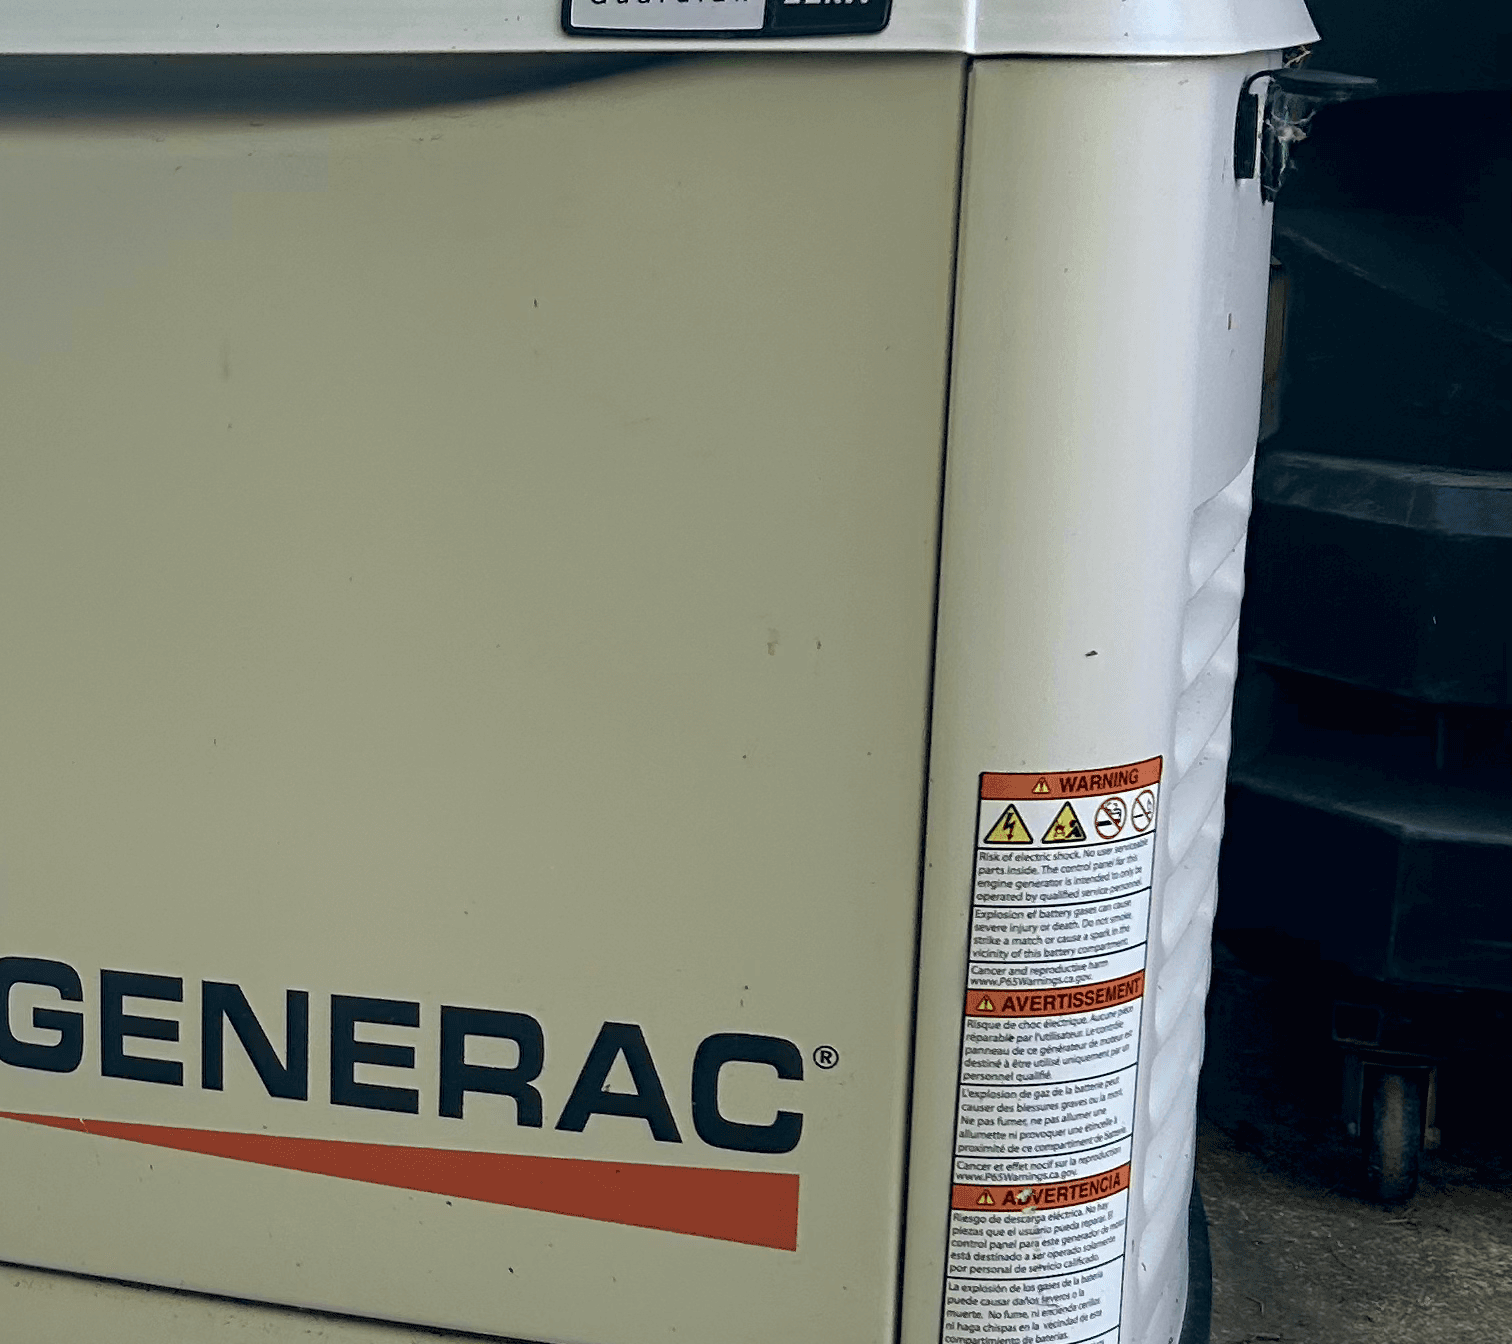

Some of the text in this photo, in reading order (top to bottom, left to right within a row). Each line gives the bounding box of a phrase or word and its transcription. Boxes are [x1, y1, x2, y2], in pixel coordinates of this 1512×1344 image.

[1059, 768, 1140, 793] WARNING
[978, 851, 1000, 862] Risk
[1001, 851, 1014, 862] of
[1015, 852, 1051, 862] electric
[1083, 849, 1096, 858] No
[1041, 864, 1059, 874] The
[1060, 861, 1091, 873] control
[1093, 858, 1114, 871] panel
[1115, 857, 1125, 866] for
[977, 872, 1110, 890] engine generator is intended
[976, 891, 1023, 903] operated
[1025, 891, 1038, 903] by
[1039, 888, 1080, 903] qualified
[975, 909, 1025, 920] Explosion
[1026, 909, 1038, 919] of
[1039, 908, 1072, 919] battery
[1073, 906, 1097, 919] gases
[974, 916, 1108, 934] severe injury or Do not
[973, 936, 1002, 946] strike
[1003, 938, 1010, 946] a
[1011, 935, 1043, 946] match
[1044, 937, 1056, 945] or
[1057, 934, 1082, 944] cause
[972, 947, 1076, 960] vicinity of this battery
[971, 965, 1007, 976] Cancer
[1008, 966, 1028, 976] and
[1001, 977, 1142, 1013] AVERTISSEMENT
[967, 1019, 1042, 1031] Risque de choc
[965, 1047, 1010, 1056] panneau
[1011, 1047, 1026, 1056] de
[1026, 1047, 1039, 1056] ce
[1088, 1039, 1099, 1049] de
[1016, 1035, 1034, 1045] par
[963, 1071, 1015, 1082] personnel
[1019, 1089, 1032, 1099] de
[1033, 1090, 1050, 1101] gaz
[1051, 1087, 1064, 1097] de
[1065, 1086, 1073, 1095] la
[960, 1103, 995, 1112] causer
[996, 1102, 1015, 1113] des
[1016, 1101, 1059, 1113] blessures
[1060, 1098, 1088, 1111] graves
[1088, 1097, 1099, 1105] ou
[960, 1115, 976, 1125] Ne
[977, 1118, 995, 1128] pas
[1044, 1116, 1060, 1127] pas
[1061, 1111, 1092, 1123] allumer
[1092, 1108, 1107, 1117] une
[959, 1126, 1084, 1141] allumette ni provoquer une
[1007, 1144, 1020, 1154] de
[1021, 1145, 1033, 1153] ce
[956, 1161, 992, 1171] Cancer
[993, 1163, 1005, 1172] et
[1031, 1159, 1054, 1170] nocif
[1055, 1160, 1068, 1169] sur
[1069, 1157, 1077, 1166] la
[953, 1205, 1096, 1225] Riesgo de descarga No
[951, 1239, 988, 1249] control
[989, 1239, 1017, 1251] panel
[1018, 1241, 1040, 1250] para
[1100, 1225, 1109, 1235] de
[952, 1227, 984, 1236] piezas
[985, 1229, 1005, 1238] que
[1007, 1227, 1016, 1237] el
[973, 1252, 1023, 1262] destinado
[1023, 1253, 1030, 1261] a
[1031, 1252, 1046, 1260] ser
[1046, 1247, 1082, 1260] operado
[949, 1262, 1063, 1275] por personal de servicio
[948, 1281, 959, 1291] La
[1009, 1284, 1021, 1293] de
[1036, 1282, 1060, 1294] gases
[1061, 1278, 1073, 1288] de
[1073, 1277, 1080, 1286] la
[947, 1288, 1085, 1307] puede causar o la
[988, 1309, 1040, 1319] No ni
[945, 1322, 955, 1330] ni
[956, 1322, 981, 1334] haga
[982, 1323, 1017, 1335] chispas
[1031, 1321, 1040, 1331] la
[1079, 1314, 1089, 1324] de
[1021, 1336, 1034, 1344] de
